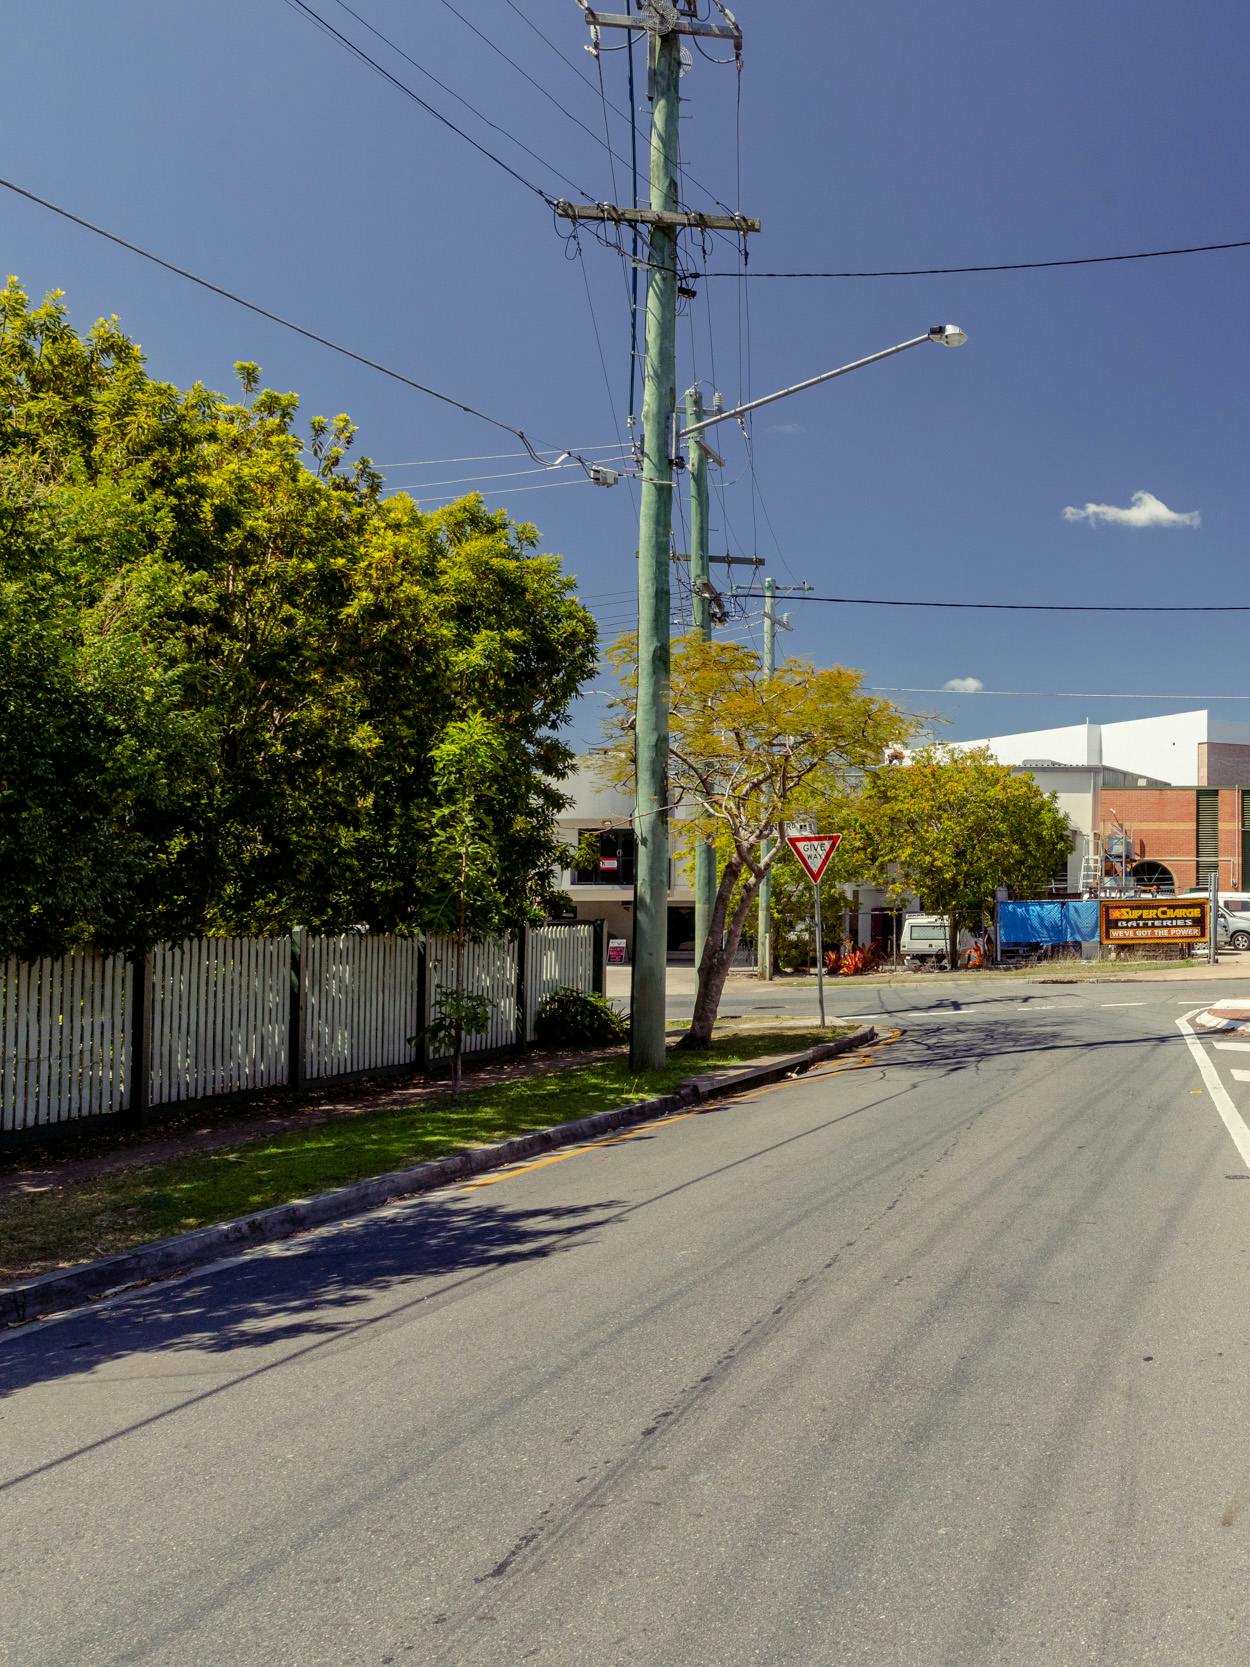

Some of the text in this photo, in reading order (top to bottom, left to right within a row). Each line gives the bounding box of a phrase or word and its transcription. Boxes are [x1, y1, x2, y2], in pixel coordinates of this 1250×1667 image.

[803, 843, 826, 851] GIVE
[1154, 928, 1168, 936] THE
[1171, 928, 1199, 936] POWER
